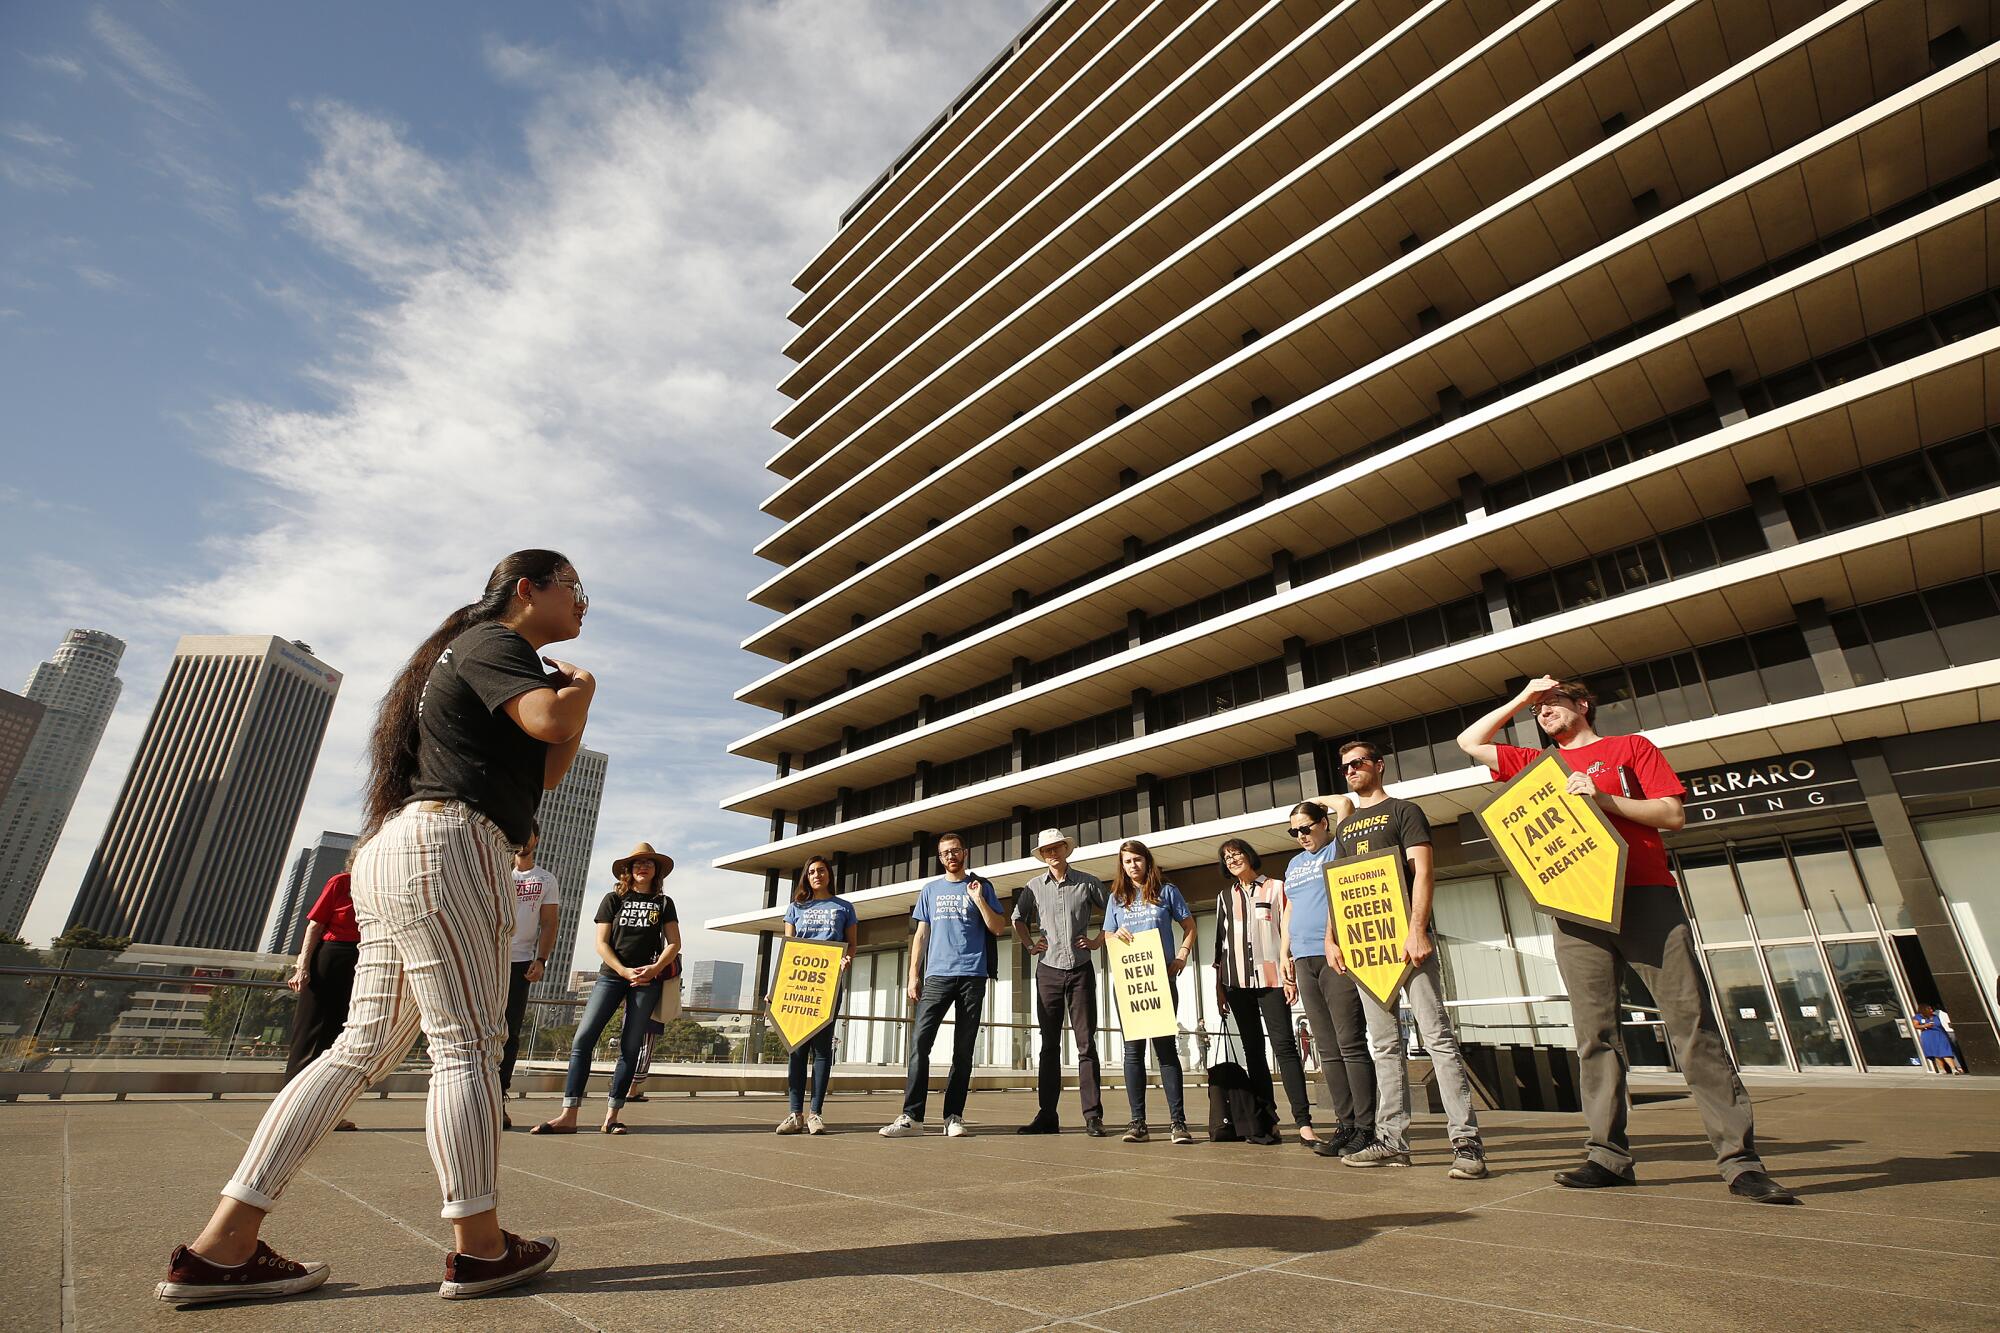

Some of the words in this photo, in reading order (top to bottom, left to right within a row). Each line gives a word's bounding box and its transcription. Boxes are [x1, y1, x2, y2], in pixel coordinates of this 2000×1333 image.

[1502, 805, 1528, 828] FOR
[1528, 782, 1556, 806] THE
[1702, 792, 1825, 820] DING
[1342, 814, 1390, 836] SUNRISE
[1524, 806, 1566, 847] AIR
[1544, 836, 1567, 857] WE
[1538, 836, 1598, 885] BREATHE
[1338, 868, 1386, 885] CALIFORNIA
[1340, 885, 1376, 901] NEEDS
[1382, 882, 1389, 894] A
[624, 901, 660, 910] GREEN
[1344, 898, 1392, 920] GREEN
[619, 917, 650, 927] DEAL
[621, 910, 648, 918] NEW
[1346, 917, 1396, 944] NEW
[792, 956, 829, 968] GOOD
[1122, 951, 1153, 964] GREEN
[1350, 944, 1402, 968] DEAL
[788, 969, 826, 984] JOBS
[1124, 964, 1154, 980] NEW
[1128, 981, 1158, 996] DEAL
[784, 993, 822, 1004] LIVABLE
[1130, 996, 1161, 1012] NOW
[781, 1004, 820, 1016] FUTURE
